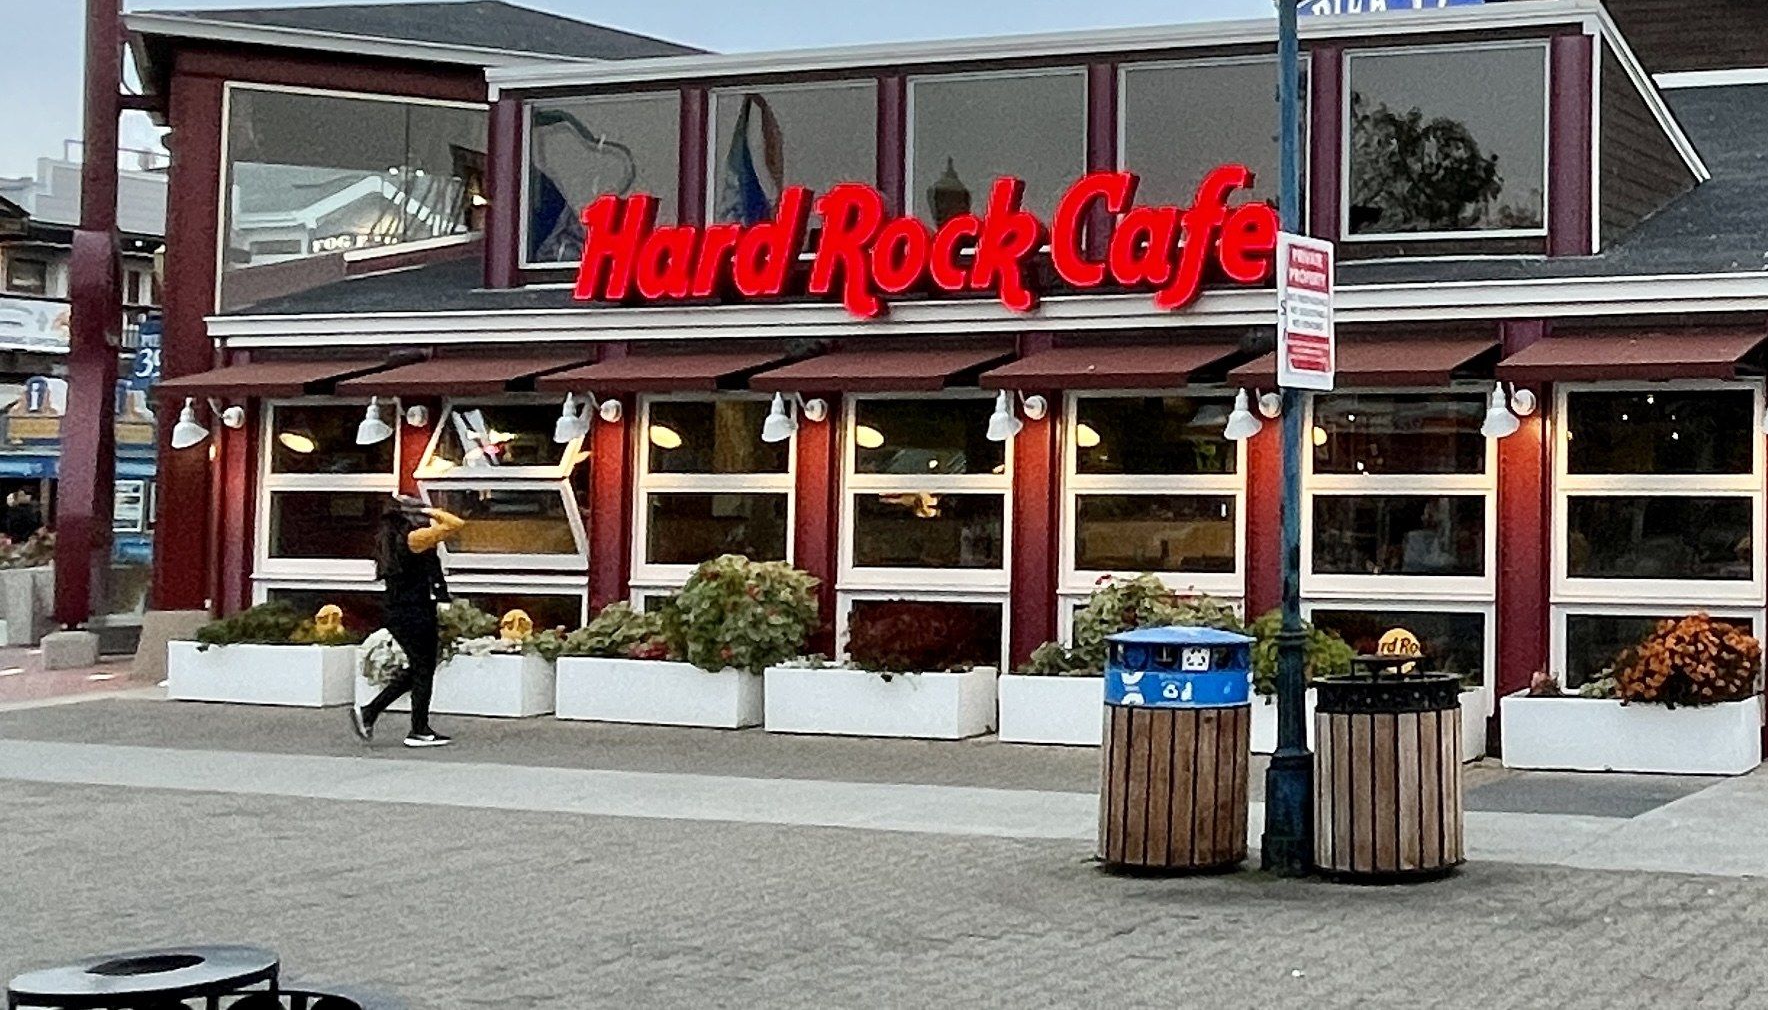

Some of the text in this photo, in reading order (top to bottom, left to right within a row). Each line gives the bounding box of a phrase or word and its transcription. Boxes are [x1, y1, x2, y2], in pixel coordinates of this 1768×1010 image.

[575, 164, 1279, 320] Hard Rock Cafe
